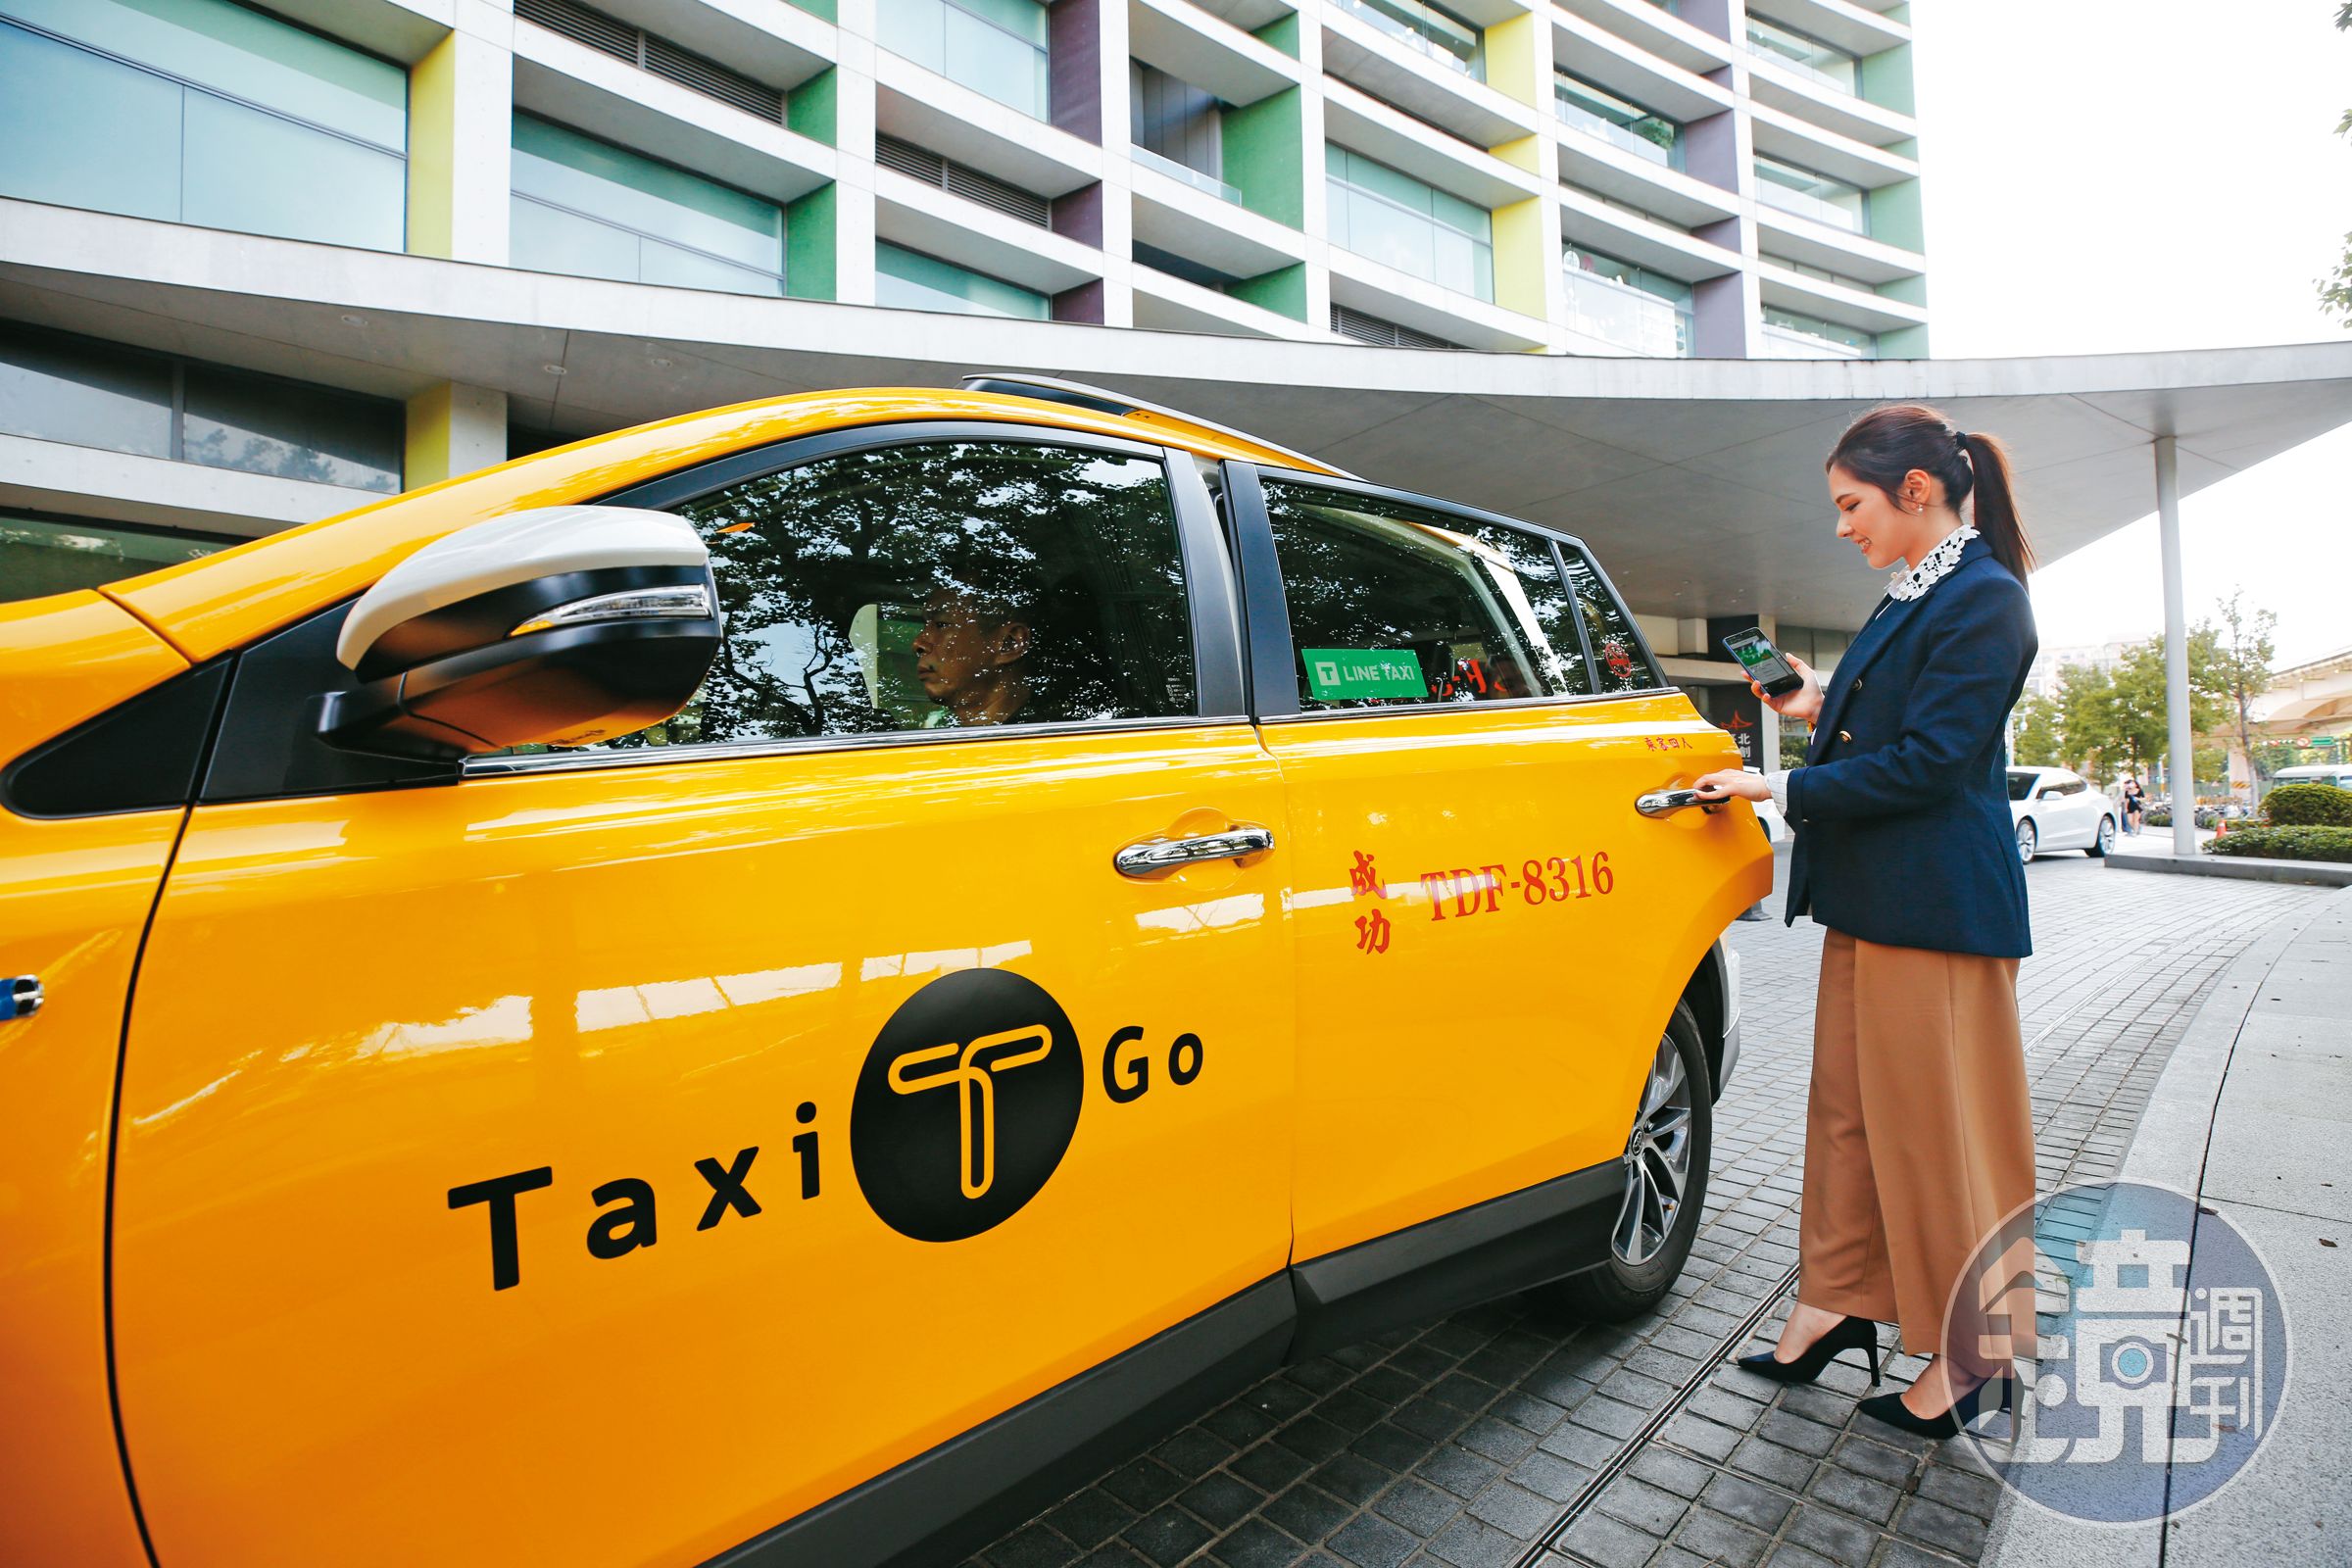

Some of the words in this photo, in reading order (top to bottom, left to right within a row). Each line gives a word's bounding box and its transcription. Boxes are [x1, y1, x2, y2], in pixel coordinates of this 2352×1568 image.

[1343, 665, 1380, 681] LINE
[1381, 663, 1415, 681] TAXI
[1348, 850, 1391, 955] 成功
[1421, 851, 1614, 921] TDF-8316
[447, 1101, 821, 1292] Taxi
[1102, 1025, 1204, 1103] Go
